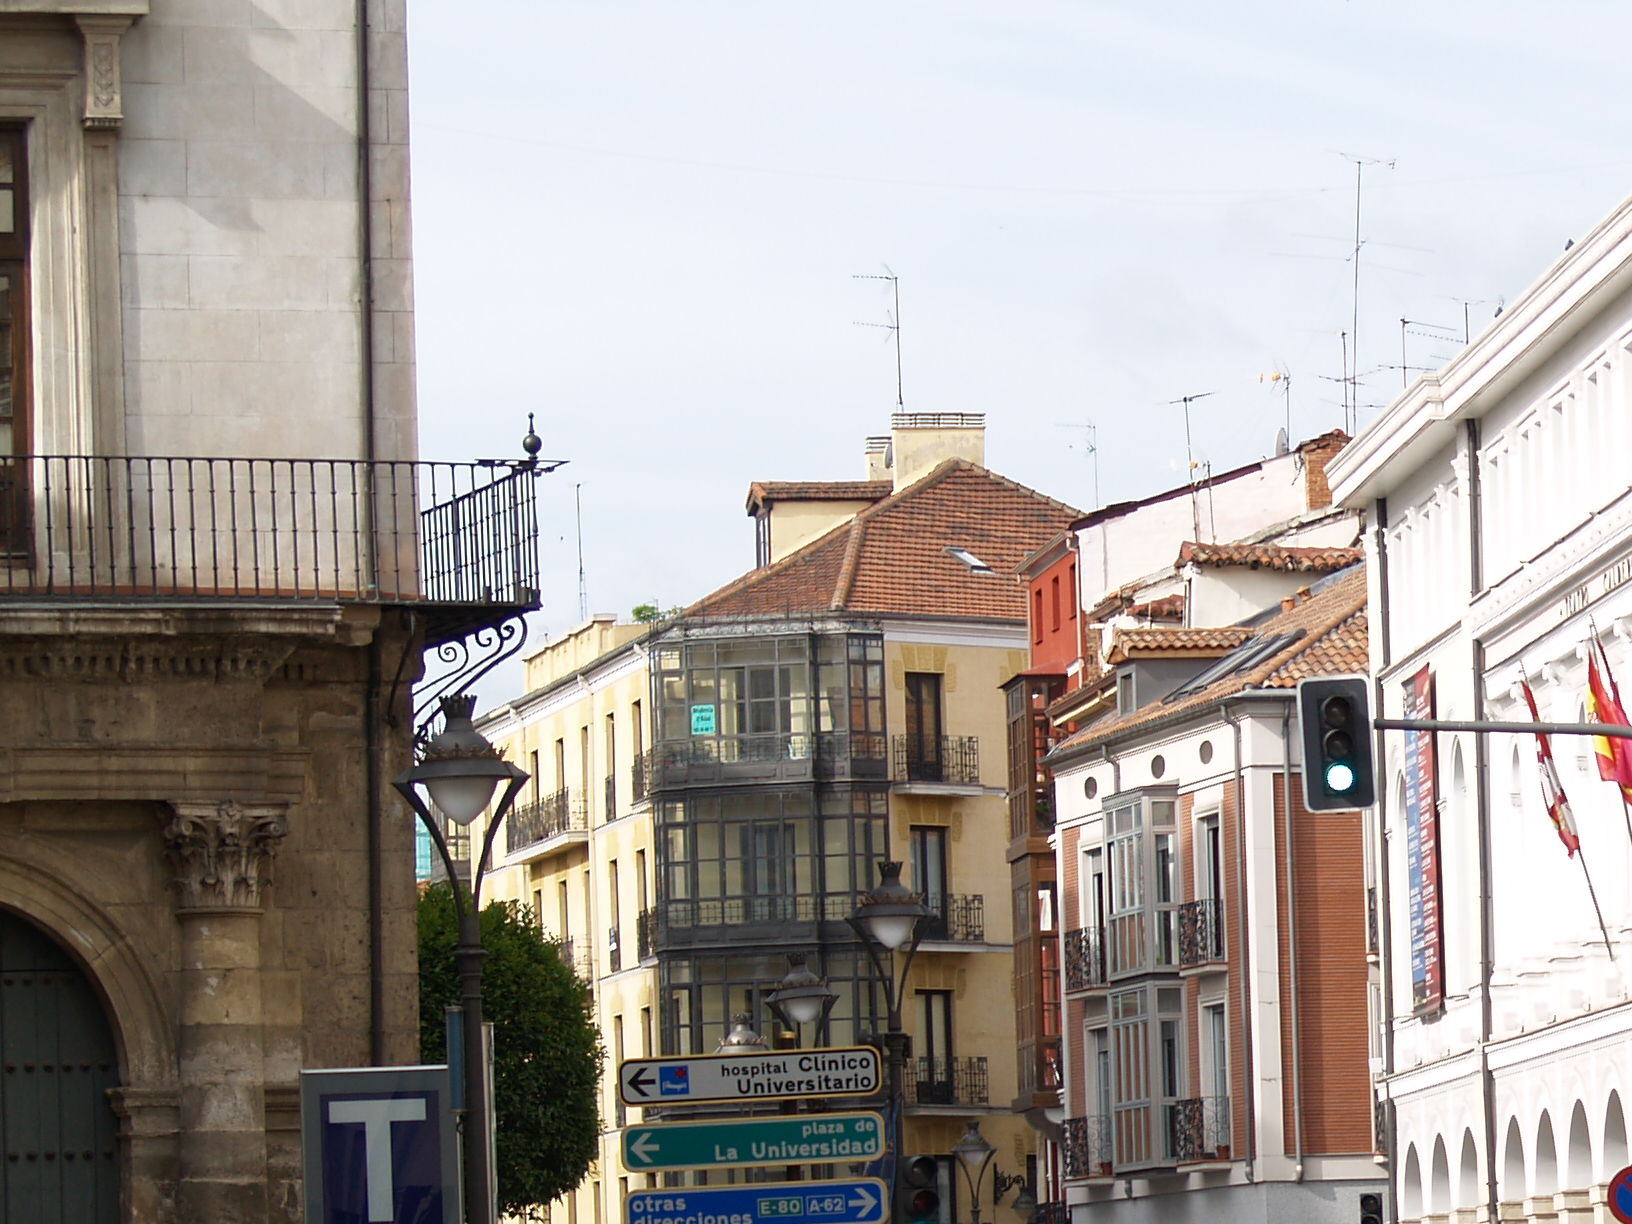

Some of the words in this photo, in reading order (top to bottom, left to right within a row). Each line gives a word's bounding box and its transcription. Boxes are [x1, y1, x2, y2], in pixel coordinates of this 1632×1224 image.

[721, 1062, 788, 1078] hospital
[798, 1055, 870, 1073] Clínico
[738, 1074, 872, 1095] Universitario
[802, 1123, 844, 1138] plaza
[855, 1120, 875, 1133] de
[328, 1098, 427, 1222] T
[715, 1145, 738, 1161] La
[751, 1139, 877, 1159] Universidad
[632, 1197, 687, 1213] otras
[760, 1200, 800, 1215] E-80
[808, 1198, 844, 1213] A-62
